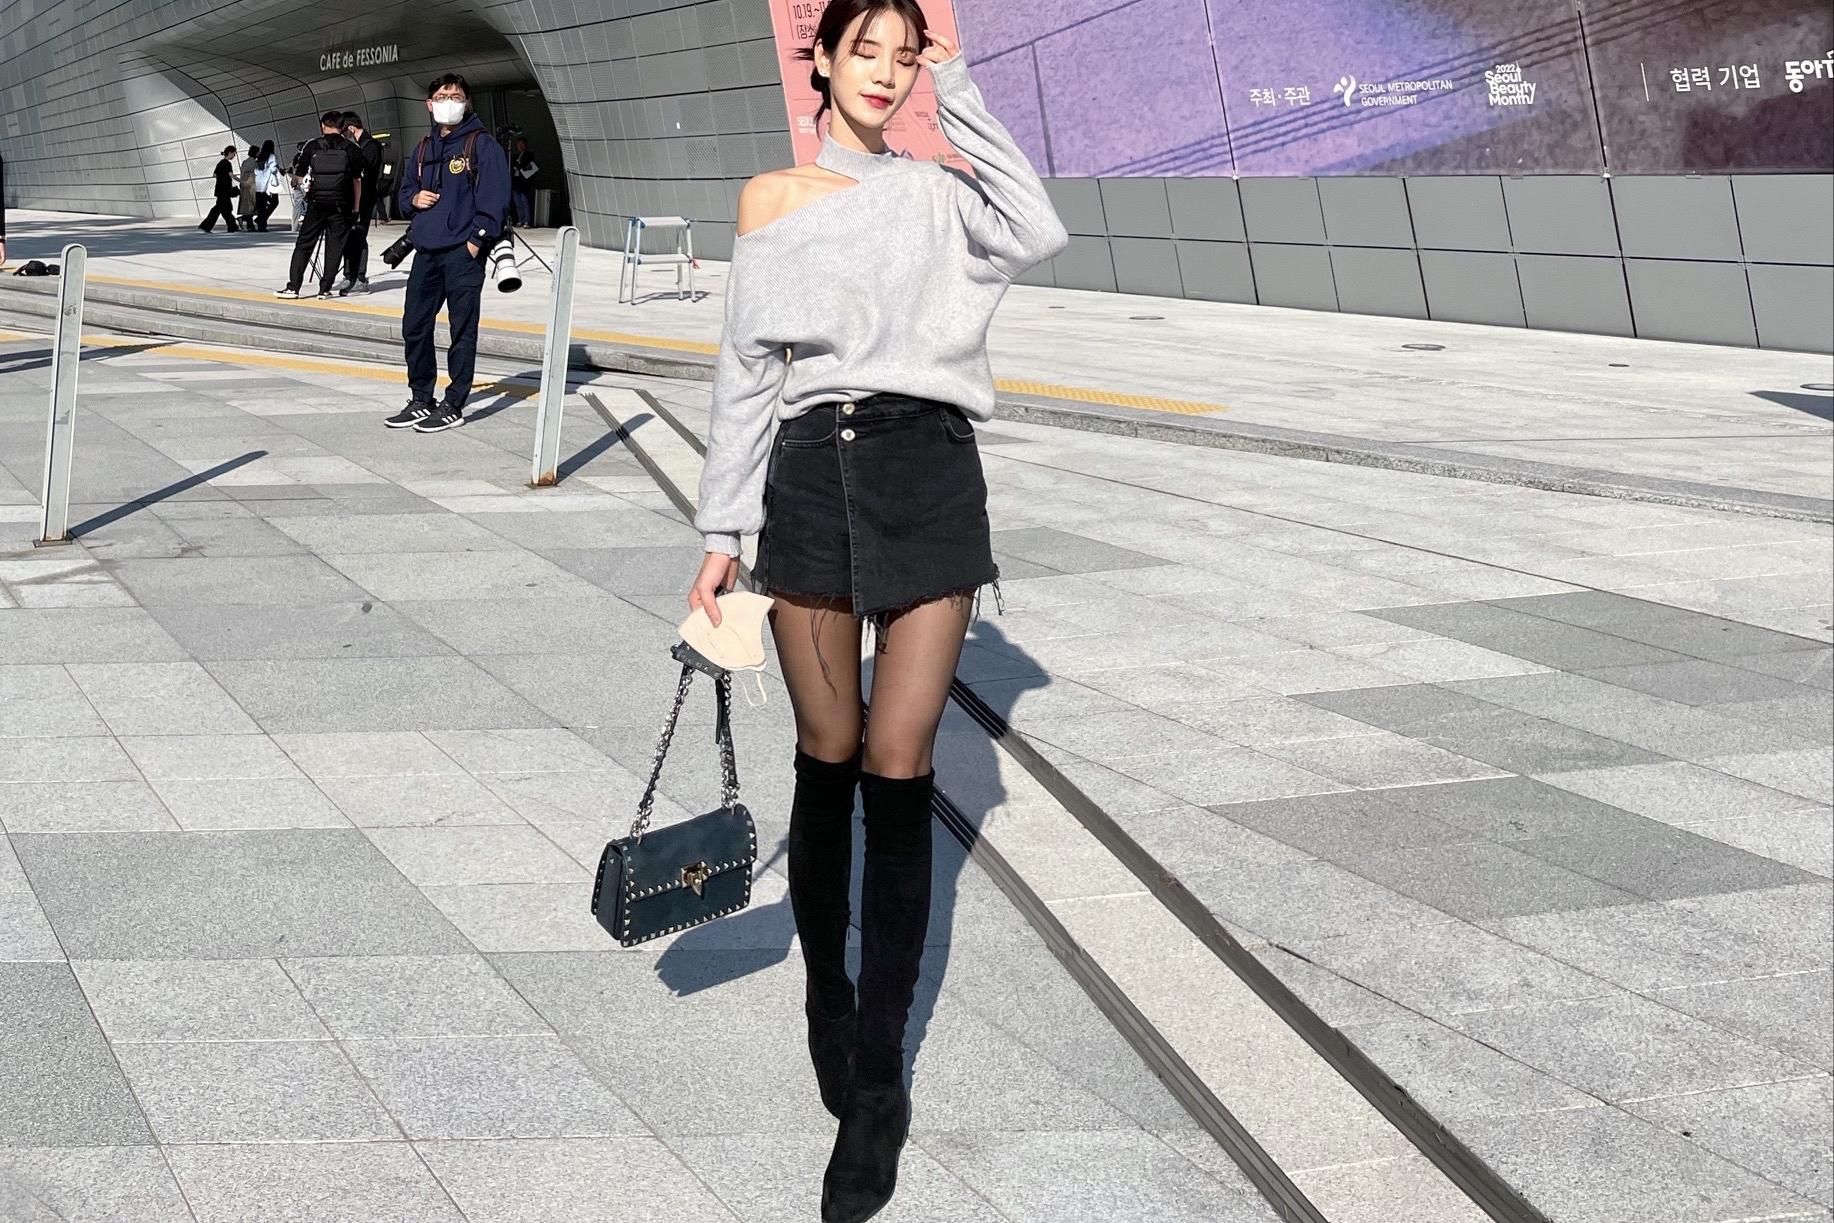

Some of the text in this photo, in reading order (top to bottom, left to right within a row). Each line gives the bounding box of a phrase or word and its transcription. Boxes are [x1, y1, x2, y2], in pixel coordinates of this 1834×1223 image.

[320, 44, 399, 71] CAFE de FESSONIA
[1485, 66, 1522, 84] Seoul
[1495, 64, 1516, 73] 2022
[1670, 63, 1760, 92] 협력 기업
[1359, 80, 1453, 94] SEOUL METROPOLITAN
[1490, 81, 1536, 104] Beauty
[1361, 95, 1418, 107] GOVERNMENT
[1488, 92, 1530, 106] Month
